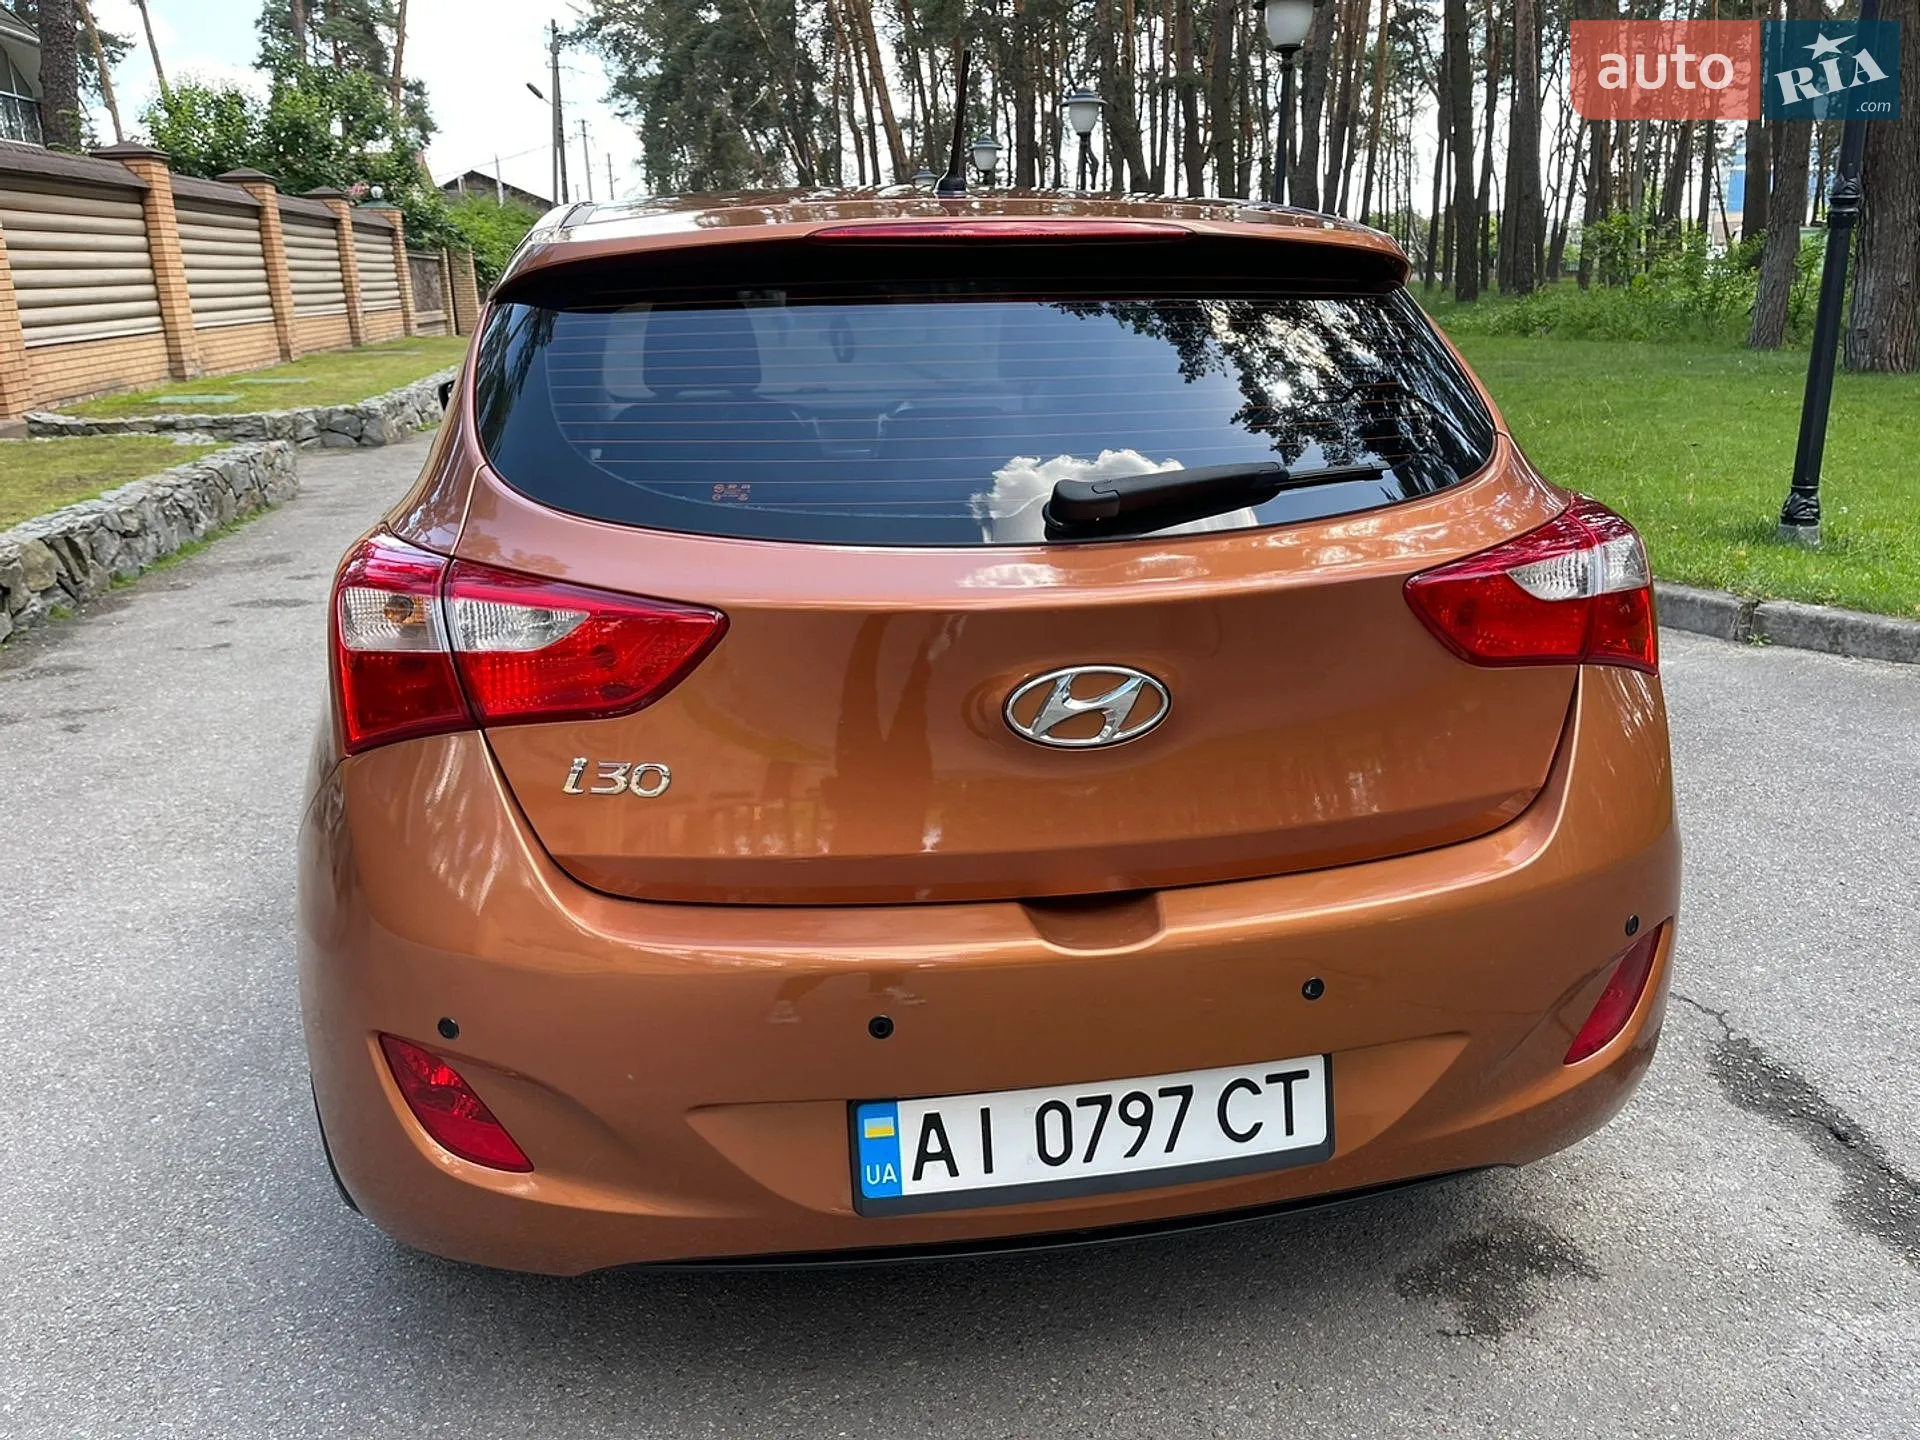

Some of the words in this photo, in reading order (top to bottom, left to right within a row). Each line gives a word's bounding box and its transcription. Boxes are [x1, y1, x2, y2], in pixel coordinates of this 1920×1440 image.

[562, 757, 671, 798] i30
[912, 1107, 993, 1182] AI
[1035, 1085, 1194, 1167] 0797
[1217, 1069, 1310, 1143] CT
[866, 1163, 898, 1185] UA
